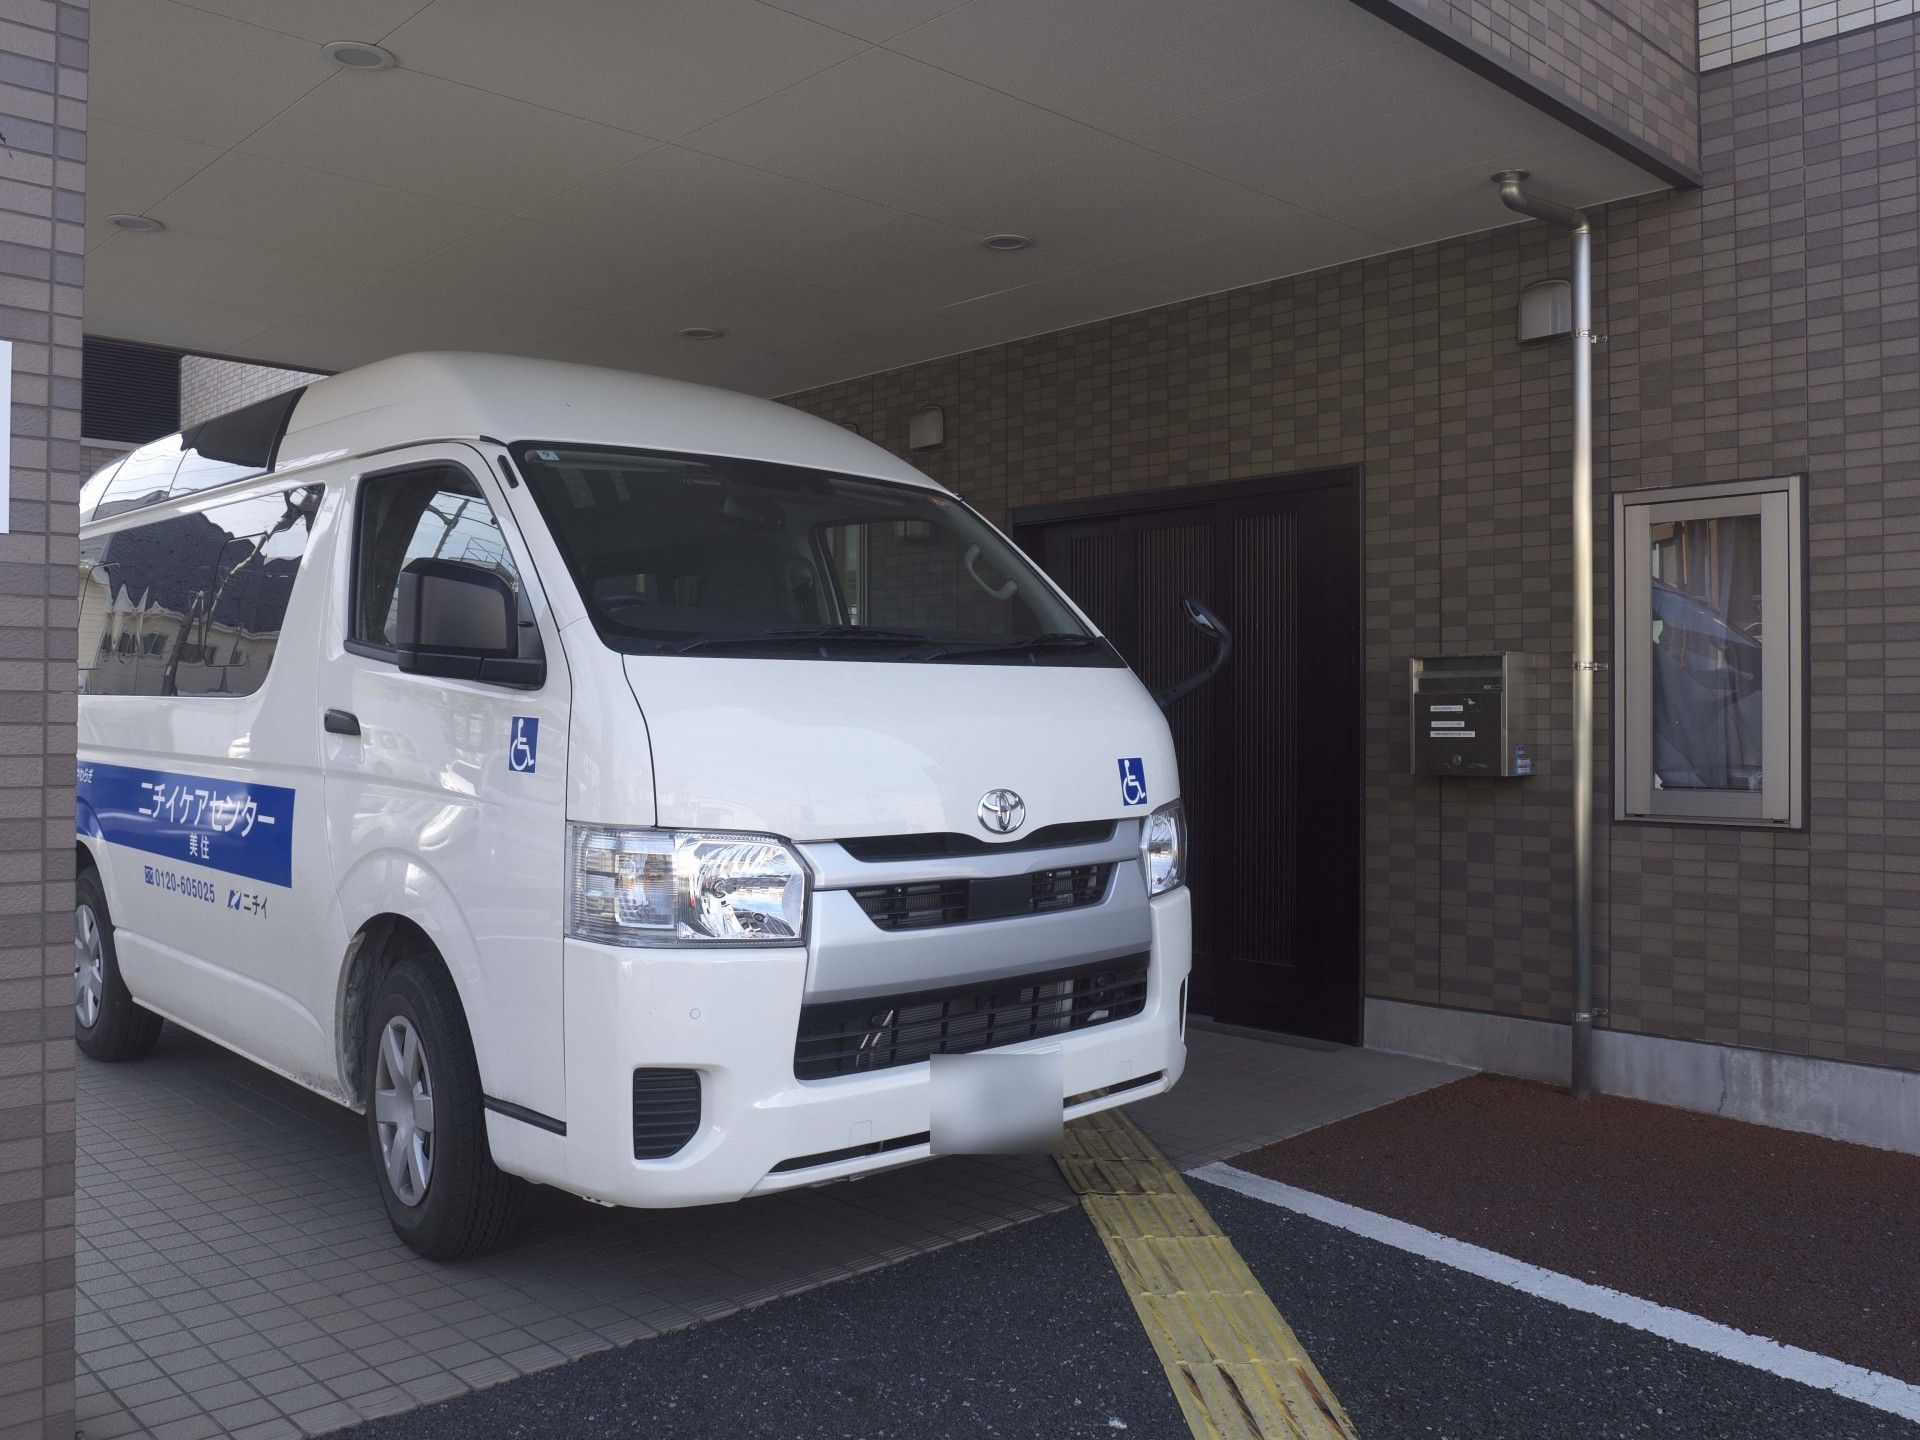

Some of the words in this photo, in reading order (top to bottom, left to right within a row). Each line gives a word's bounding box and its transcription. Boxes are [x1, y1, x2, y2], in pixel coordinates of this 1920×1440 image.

[138, 782, 275, 837] ニチイケアセンター
[189, 832, 210, 860] 美住
[155, 868, 215, 903] 0120-605025
[243, 894, 268, 919] ニチイ
